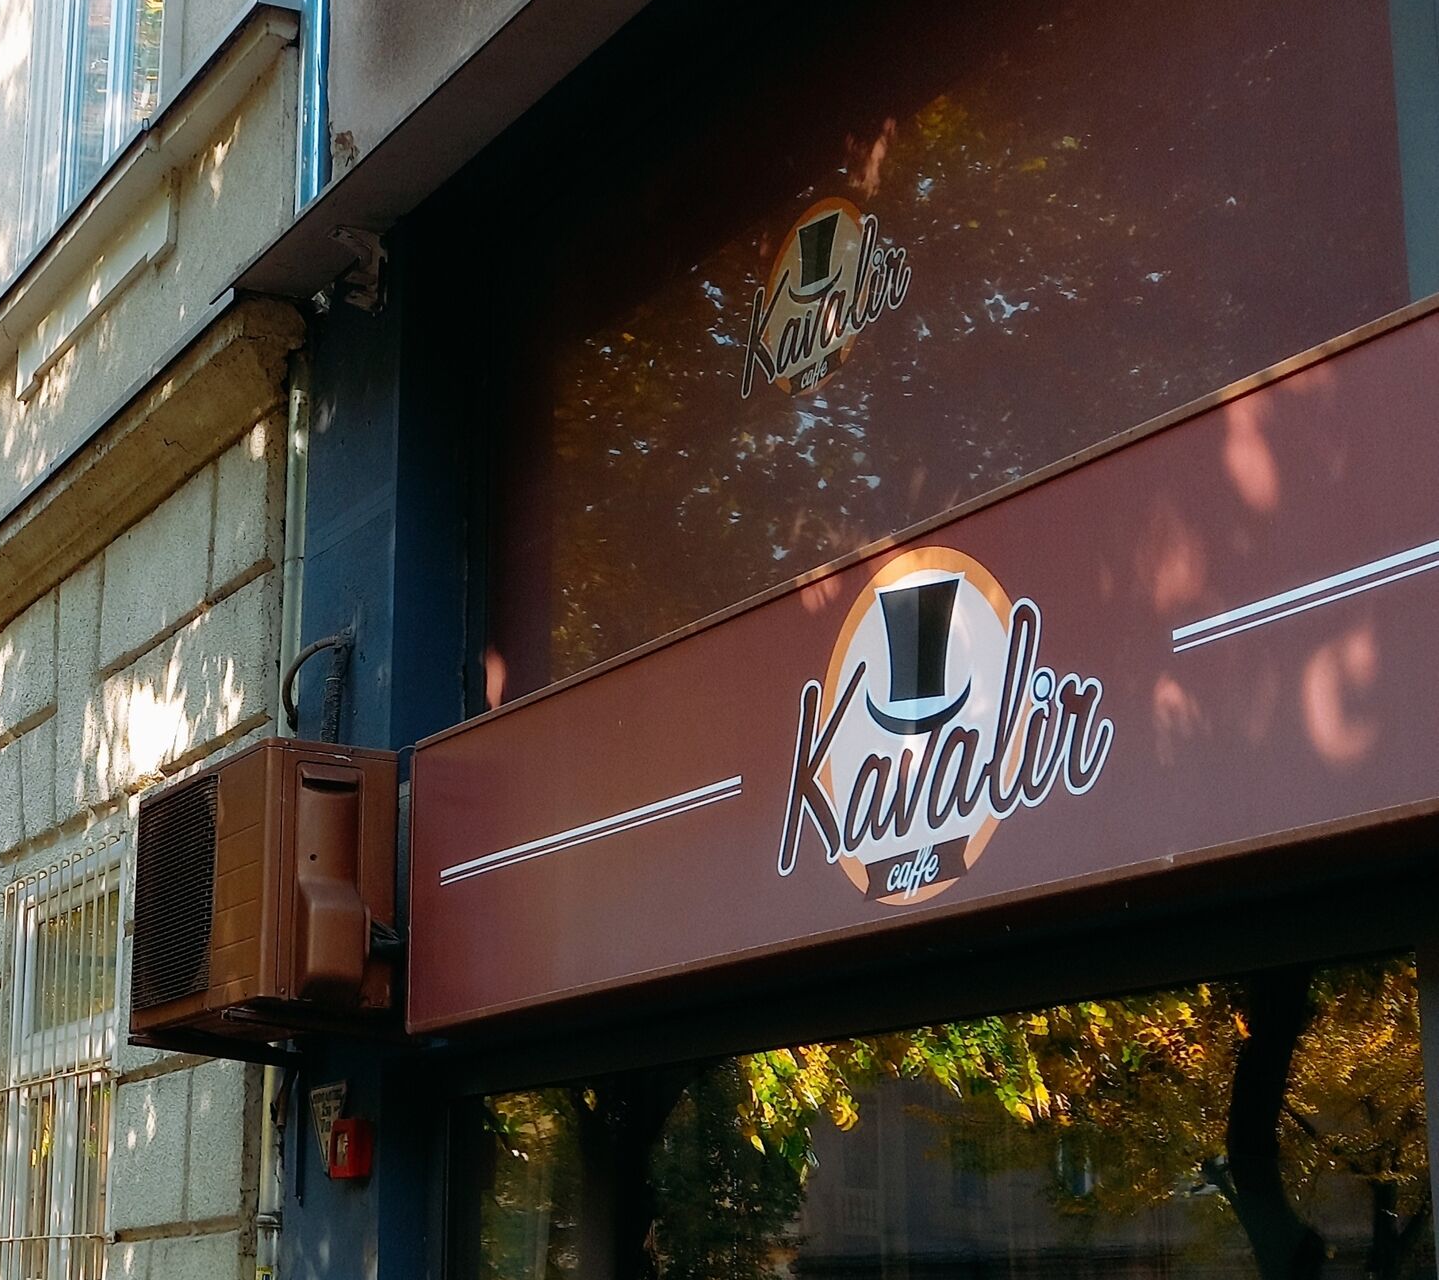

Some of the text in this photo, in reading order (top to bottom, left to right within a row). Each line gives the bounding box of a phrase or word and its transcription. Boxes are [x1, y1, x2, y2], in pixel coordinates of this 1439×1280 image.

[741, 214, 911, 399] Kavalir
[800, 359, 828, 390] caffe
[777, 597, 1114, 877] Kavalir
[886, 841, 939, 900] caffe
